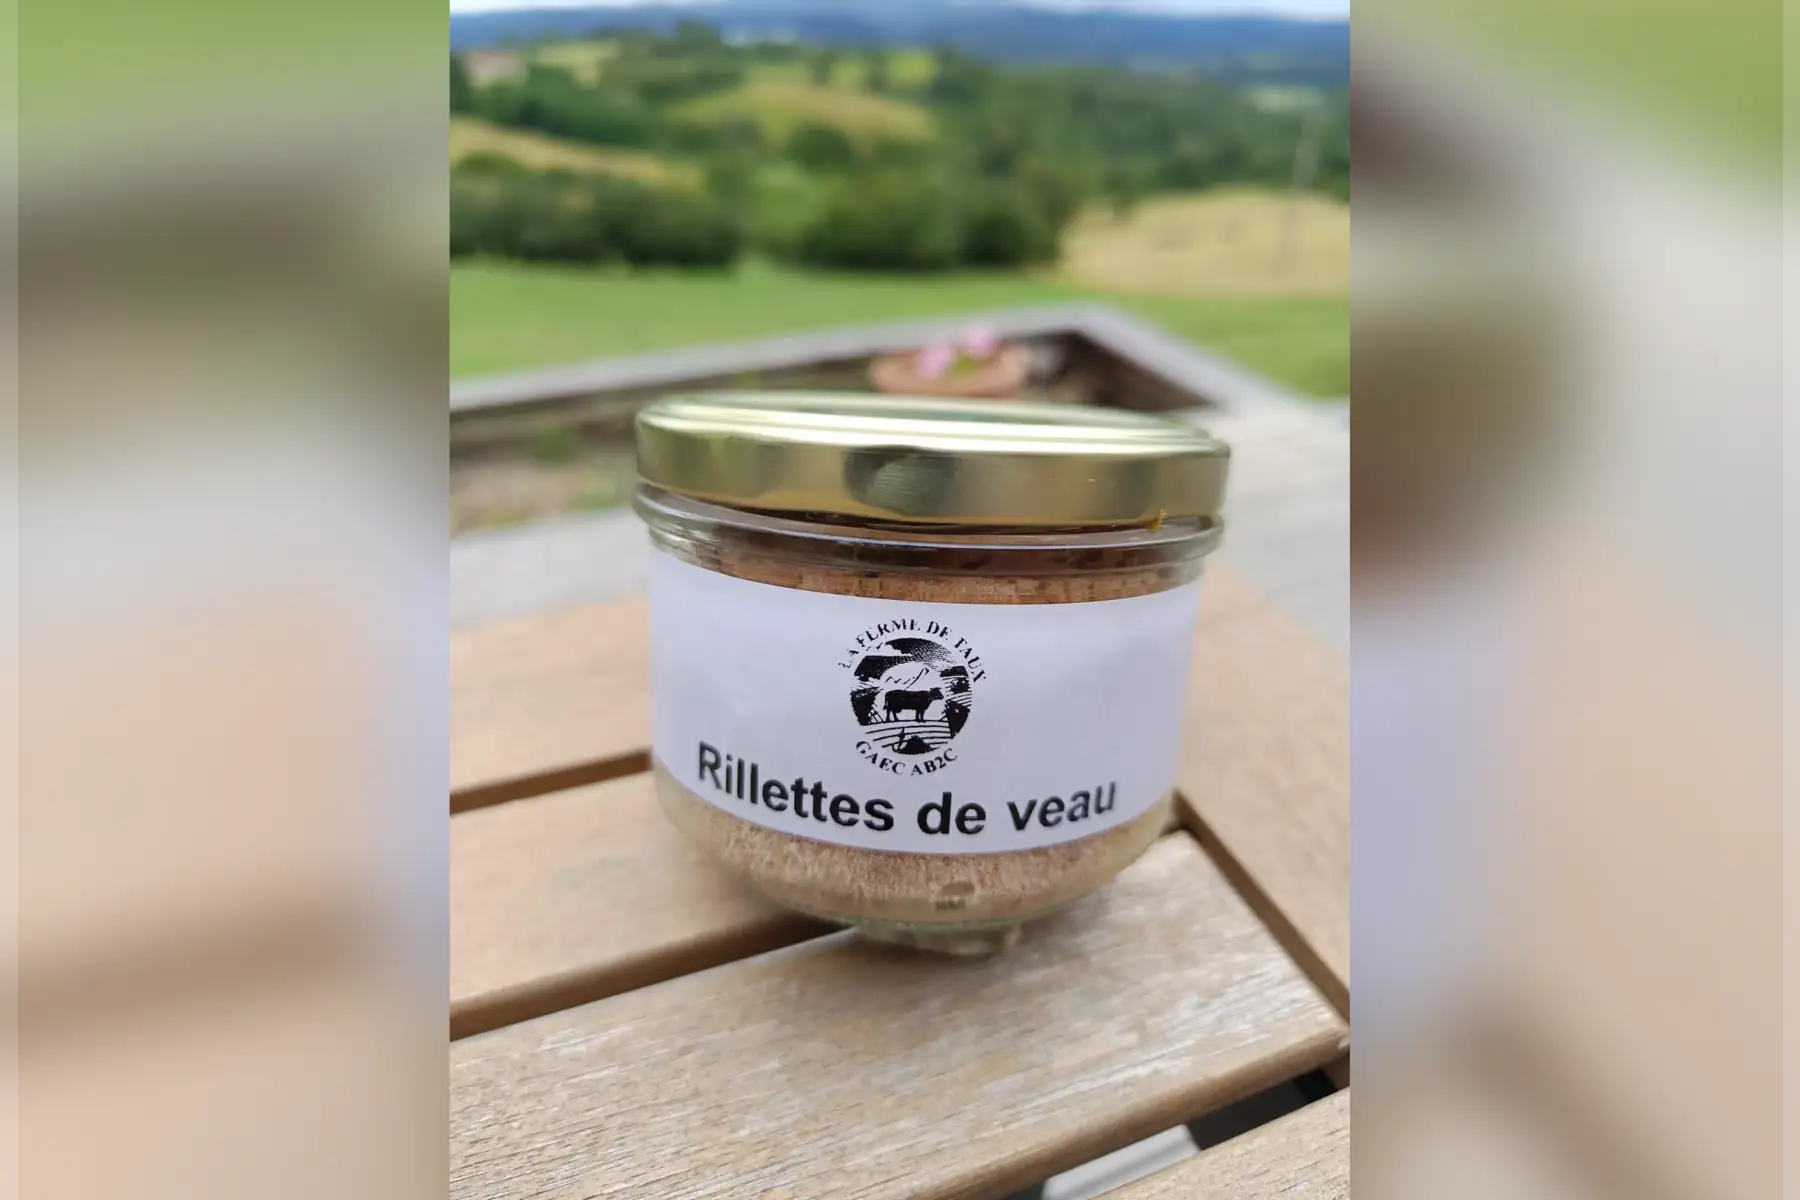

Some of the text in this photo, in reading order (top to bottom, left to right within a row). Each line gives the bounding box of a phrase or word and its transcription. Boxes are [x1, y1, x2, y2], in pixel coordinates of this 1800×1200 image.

[855, 618, 921, 647] FERME
[926, 620, 954, 641] DE
[856, 740, 958, 775] GAEC AB2C
[698, 741, 1118, 836] Rillettes de veau
